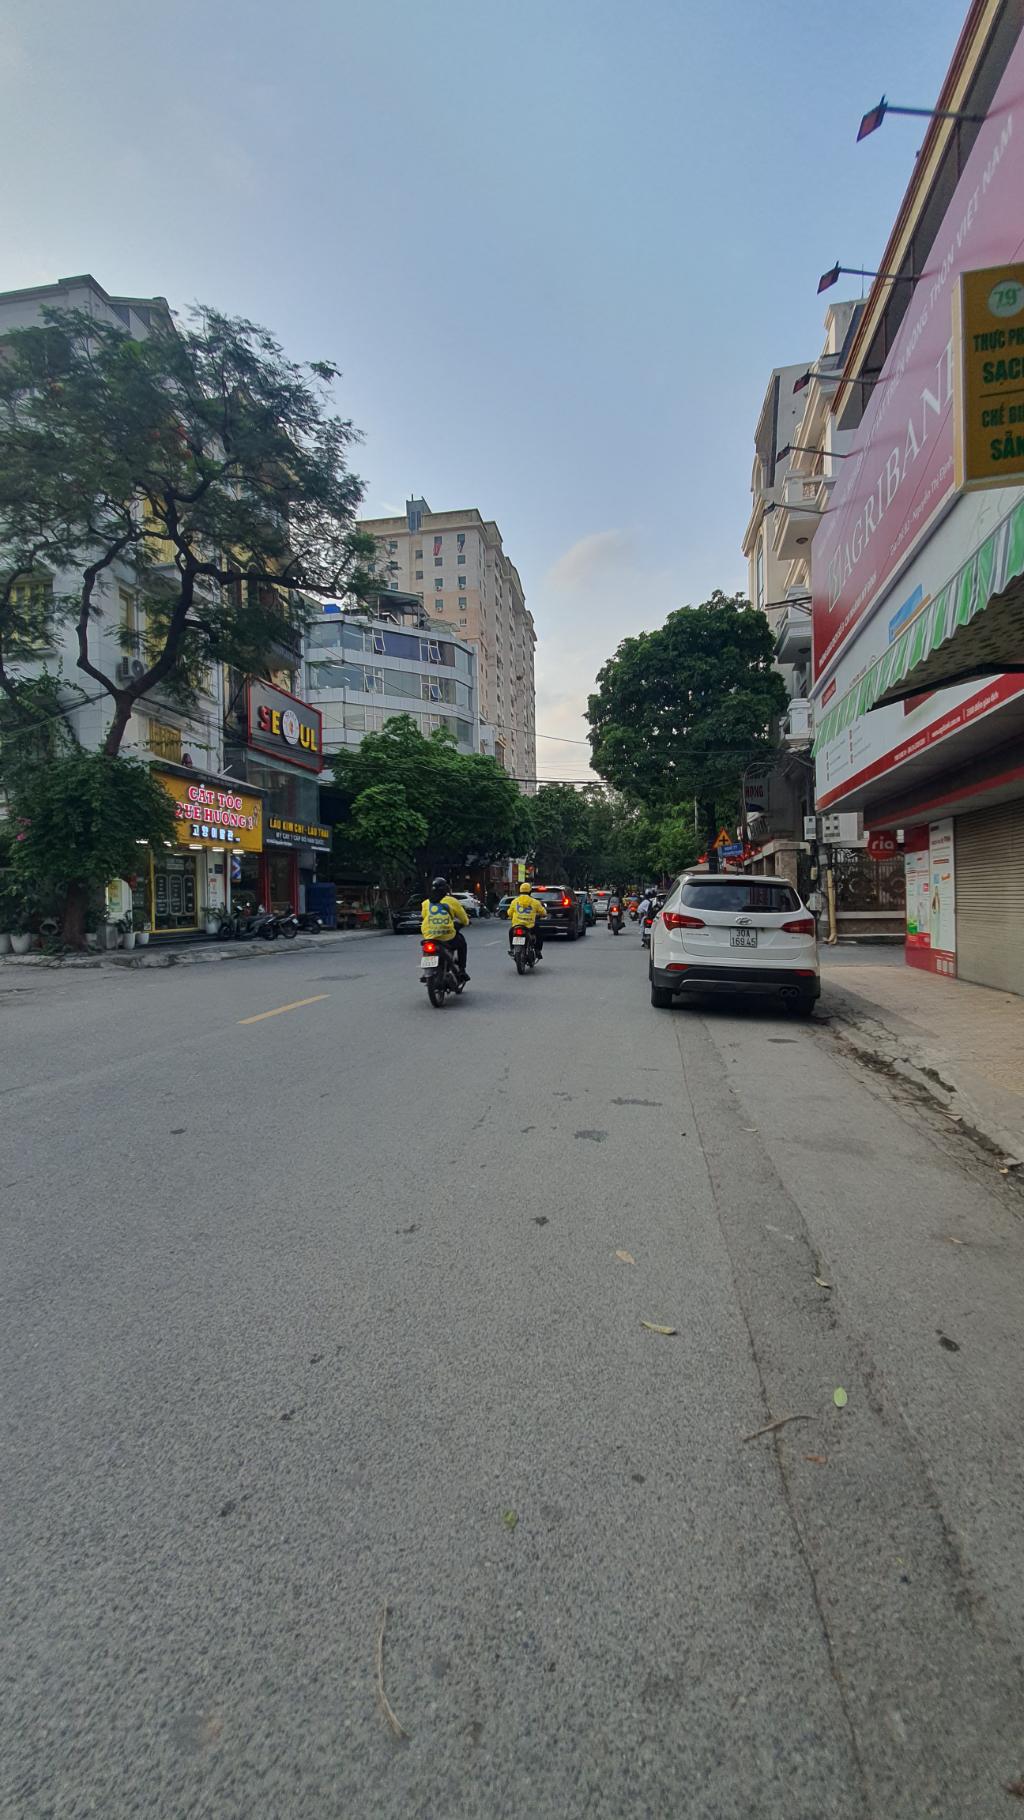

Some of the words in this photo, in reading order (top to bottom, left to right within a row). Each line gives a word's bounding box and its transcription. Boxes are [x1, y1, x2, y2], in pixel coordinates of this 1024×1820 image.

[983, 112, 1013, 195] NAM
[983, 358, 1024, 386] SẠC
[259, 705, 317, 752] SEOUL
[204, 807, 246, 828] HƯƠNG
[871, 836, 894, 850] ria
[736, 929, 751, 938] 30A
